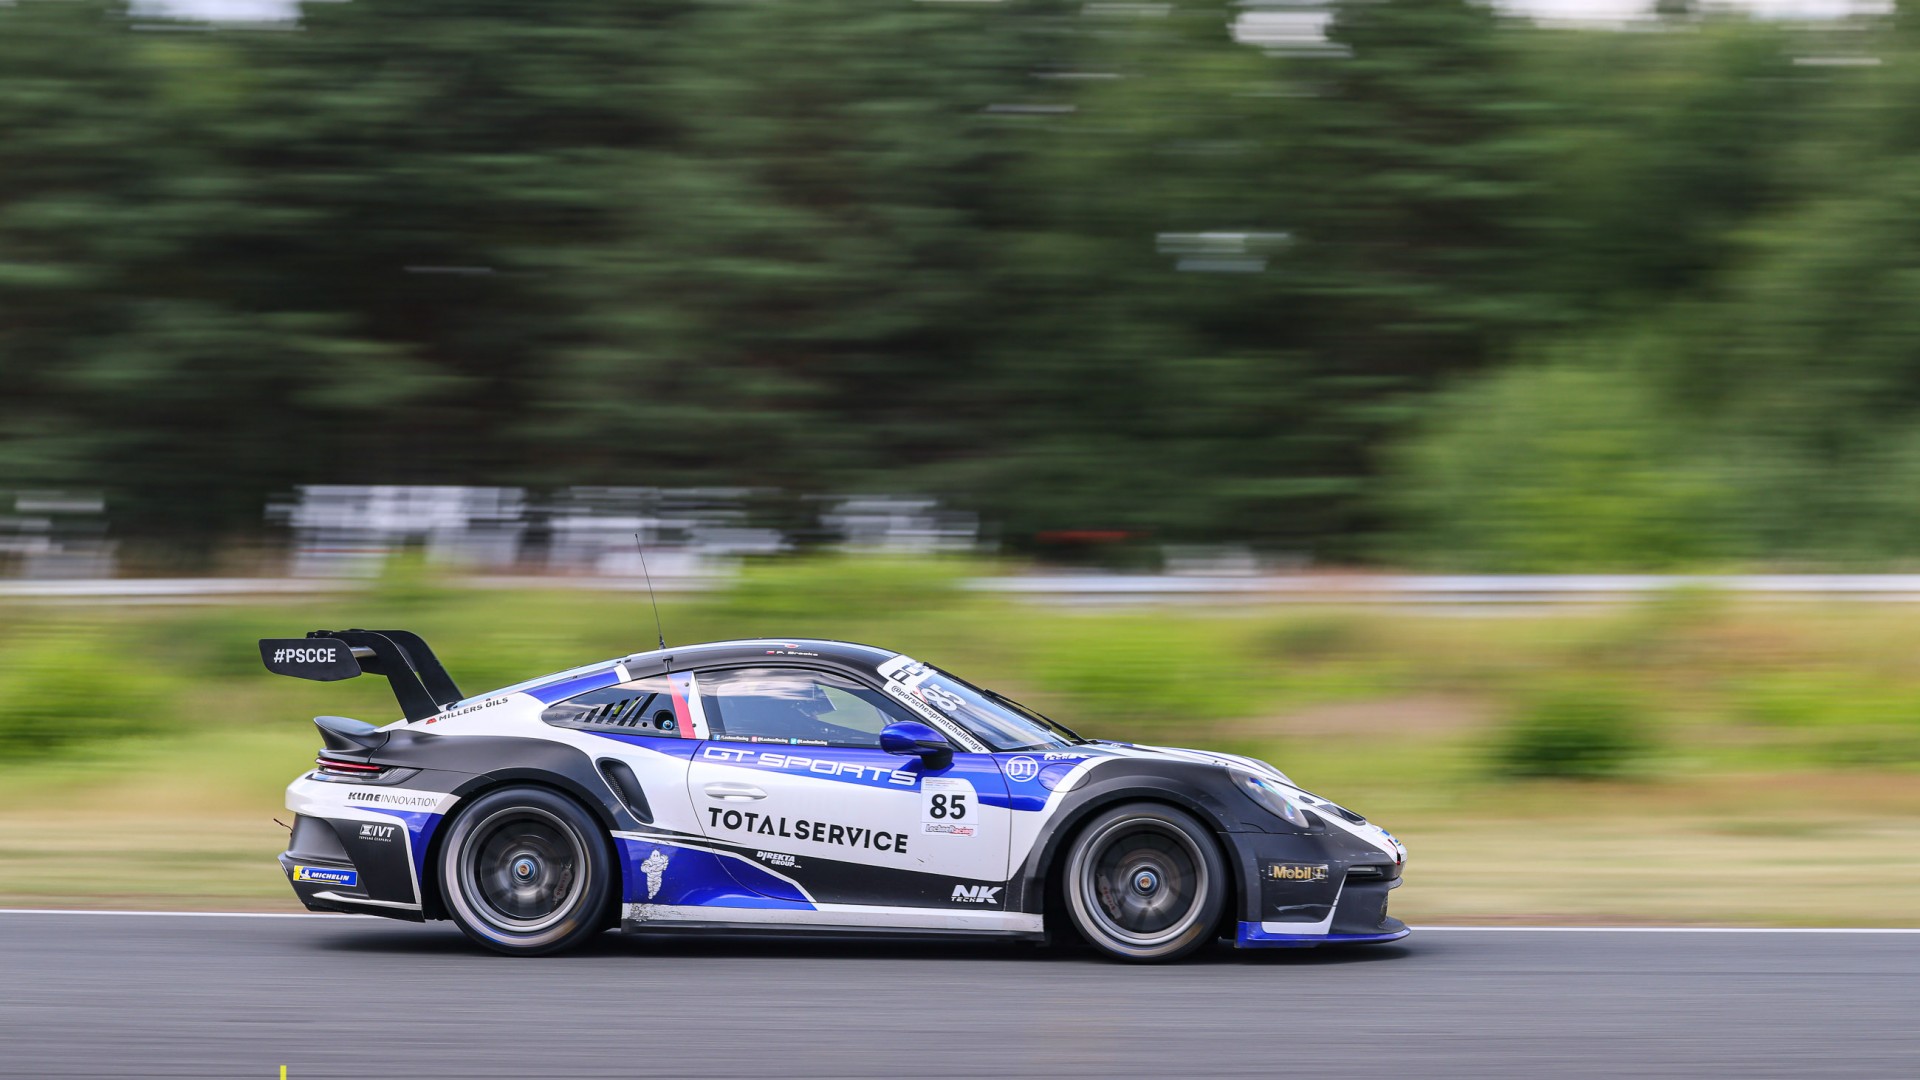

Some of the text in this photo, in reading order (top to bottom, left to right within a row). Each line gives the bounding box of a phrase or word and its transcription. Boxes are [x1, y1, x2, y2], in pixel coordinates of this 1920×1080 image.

[273, 647, 337, 664] #PSCCE
[438, 697, 509, 721] MILLERS OILS
[890, 685, 984, 752] @porschesprintchallenge
[702, 746, 755, 762] GT
[757, 752, 918, 786] SPORTS
[1009, 762, 1036, 776] DT
[929, 793, 966, 820] 85
[372, 825, 395, 838] IVT
[708, 806, 909, 854] TOTALSERVICE
[756, 850, 796, 863] DIREKTA
[770, 859, 795, 867] GROUP
[311, 871, 350, 881] MICHELIN
[1272, 865, 1312, 880] Mobil
[951, 884, 1003, 904] NK
